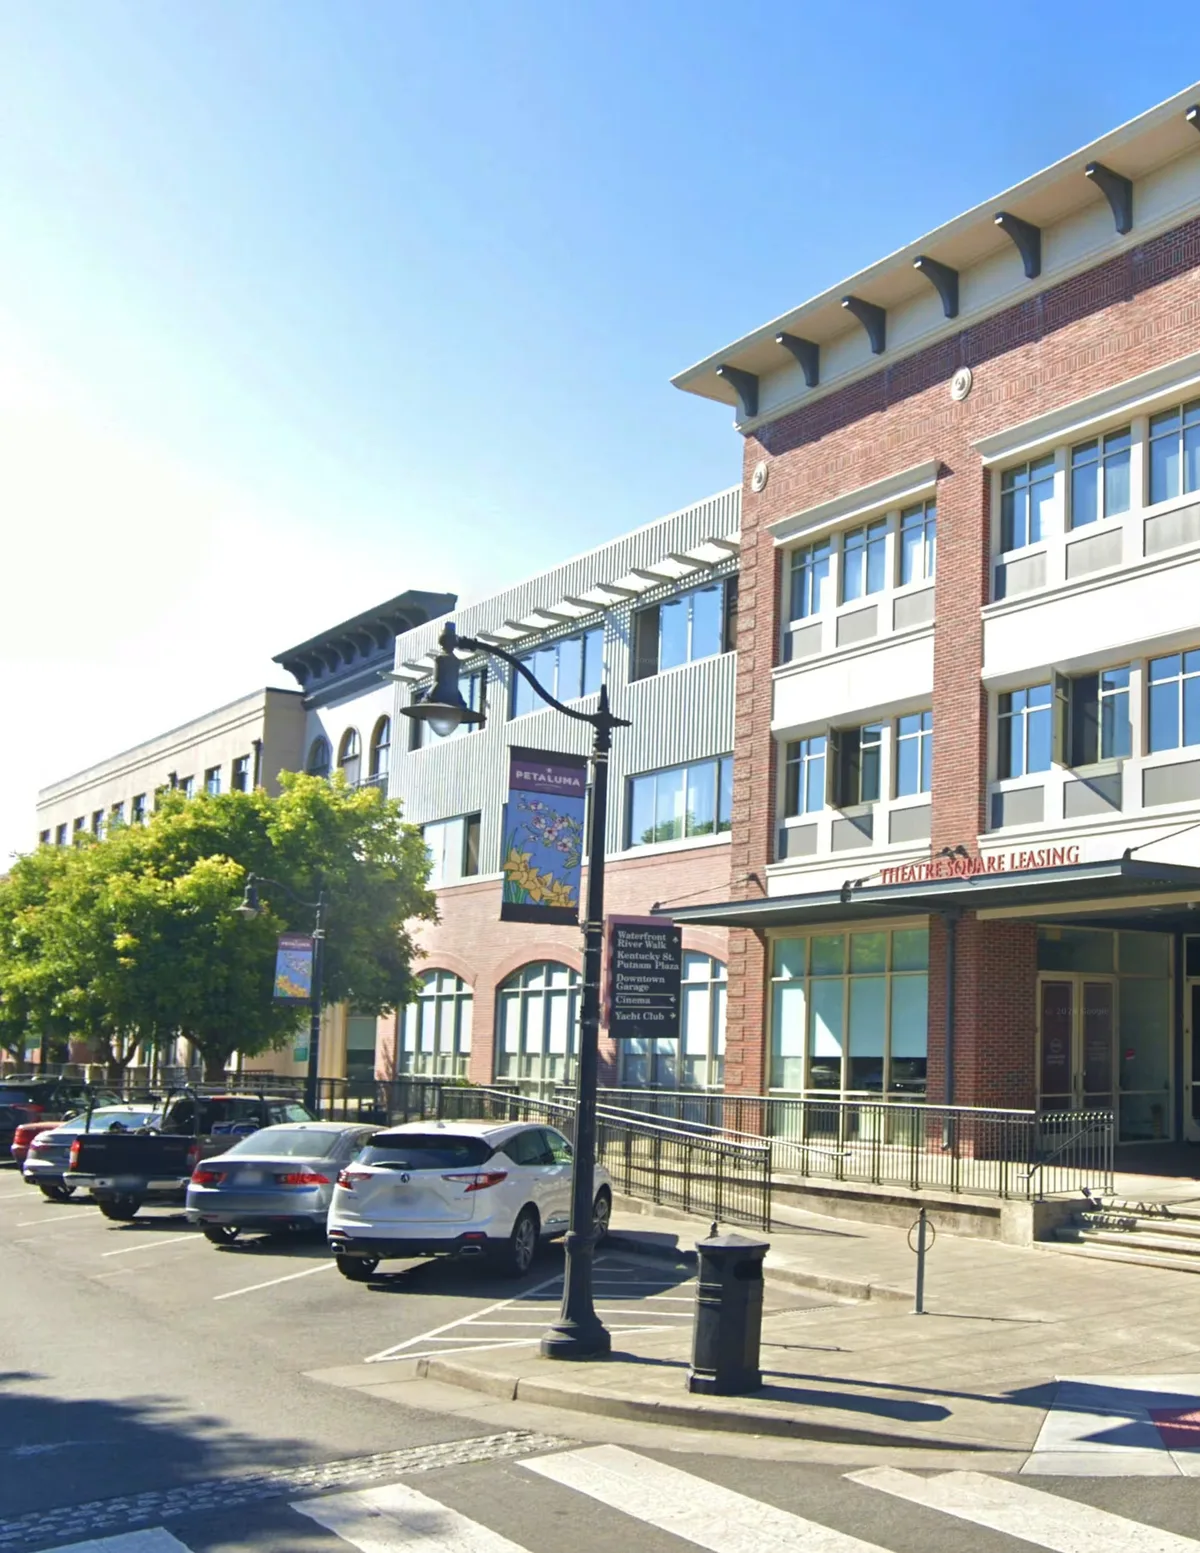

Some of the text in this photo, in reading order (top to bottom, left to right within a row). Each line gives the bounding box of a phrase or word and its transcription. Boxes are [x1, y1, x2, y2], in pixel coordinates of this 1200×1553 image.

[516, 770, 580, 787] PETALUMA
[880, 845, 1080, 884] THEATRE SQUARE LEASING
[617, 930, 667, 941] Waterfront
[617, 939, 667, 949] River Walk
[617, 951, 675, 961] Kentucky St.
[617, 960, 680, 970] Putnam Plaza
[616, 973, 665, 983] Downtown
[616, 982, 650, 992] Garage
[616, 996, 651, 1004] Cinema
[615, 1011, 665, 1020] Yacht Club
